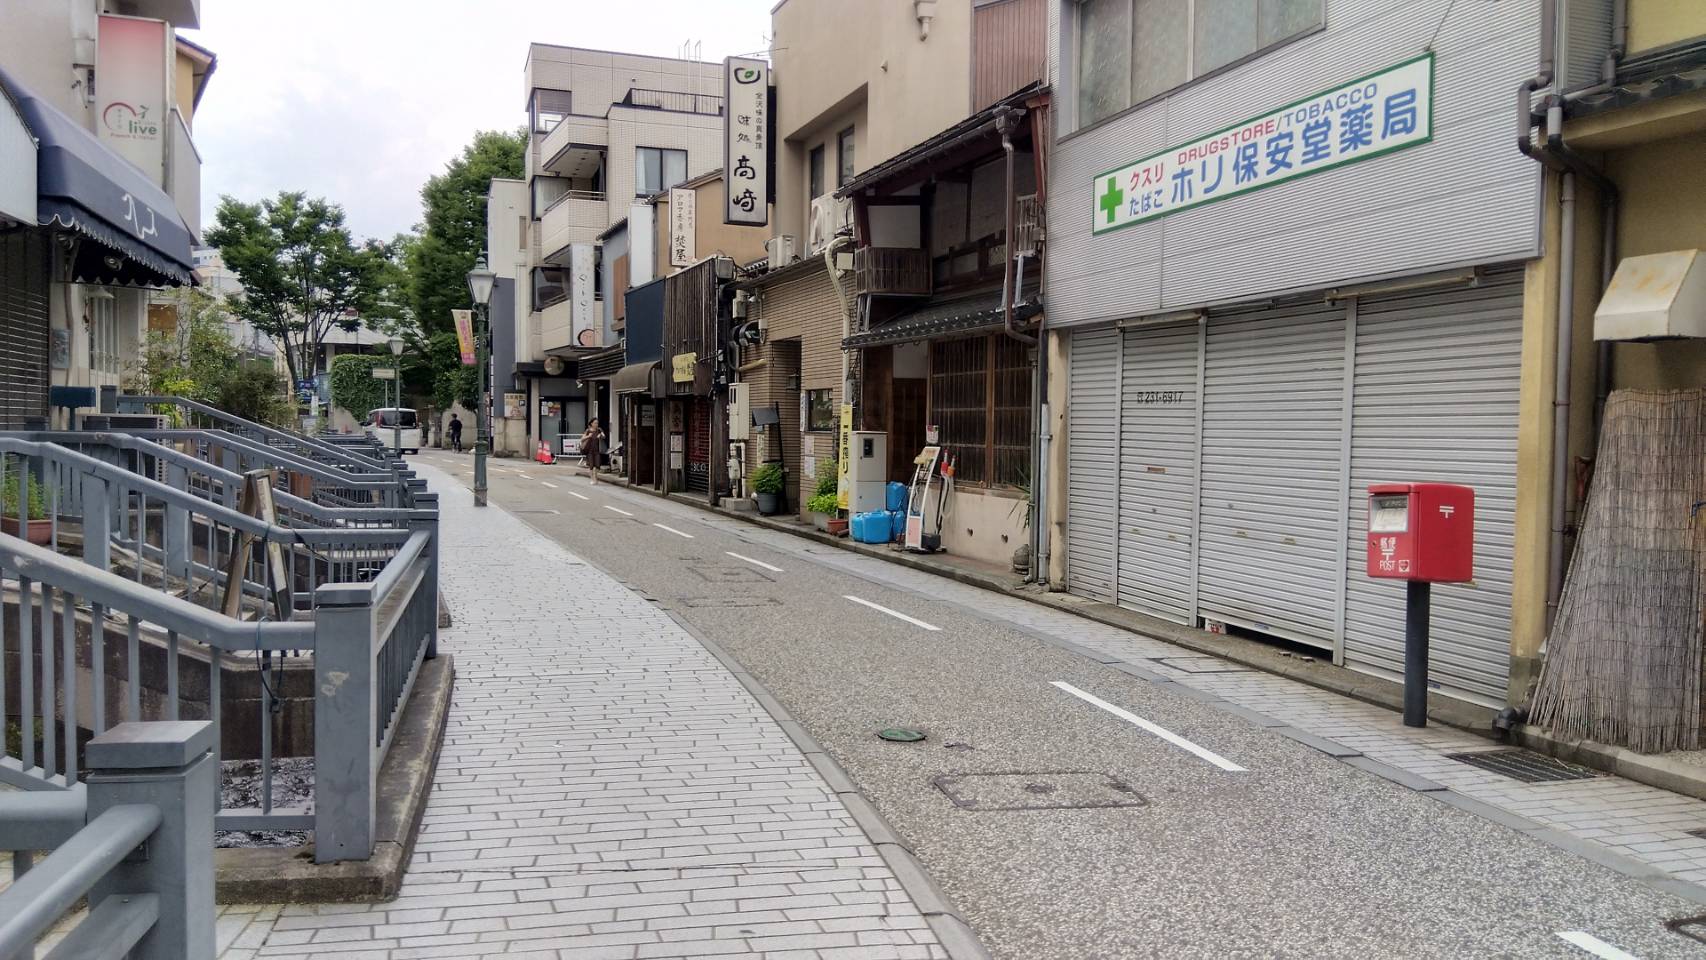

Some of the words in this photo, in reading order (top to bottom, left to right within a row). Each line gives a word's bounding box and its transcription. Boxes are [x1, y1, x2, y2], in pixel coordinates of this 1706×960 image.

[1178, 83, 1377, 165] DRUGSTORE/TOBACCO
[1171, 88, 1417, 204] ホリ保安堂薬局
[1129, 162, 1164, 191] クスリ
[1129, 189, 1163, 216] たばこ
[1380, 536, 1397, 549] 郵便
[1379, 560, 1396, 570] POST
